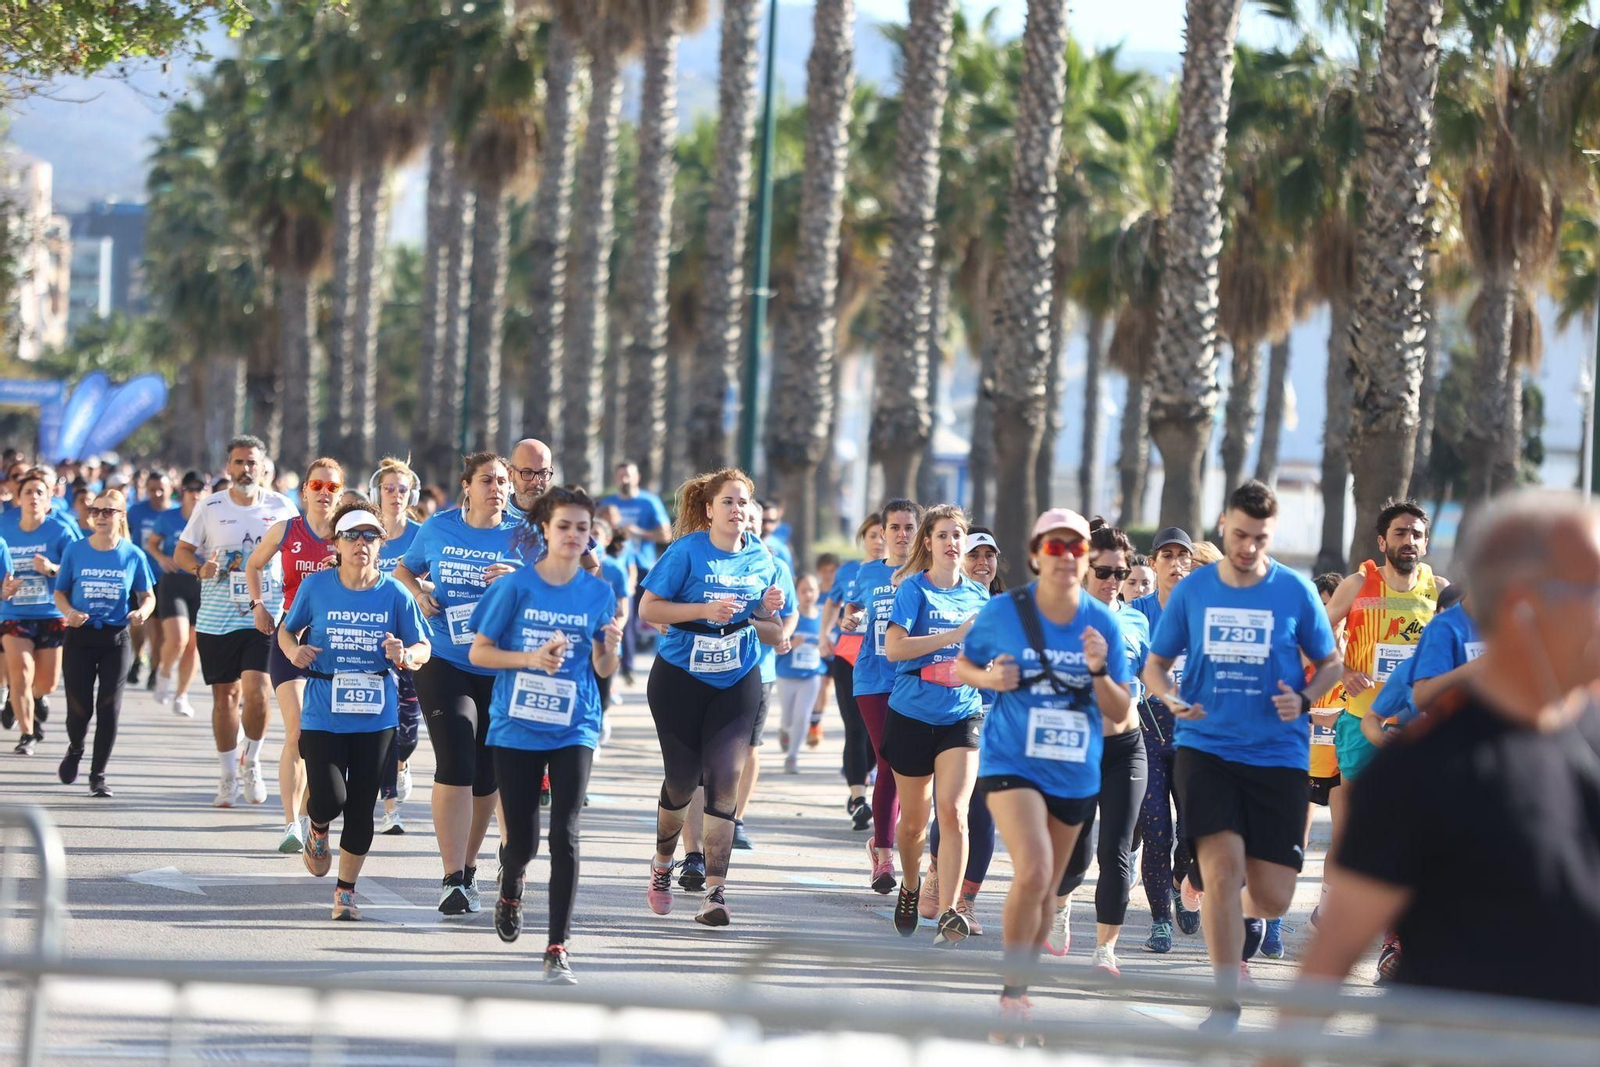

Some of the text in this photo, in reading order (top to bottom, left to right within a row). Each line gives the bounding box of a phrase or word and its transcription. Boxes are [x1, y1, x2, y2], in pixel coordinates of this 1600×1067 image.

[291, 541, 302, 554] 3
[442, 546, 501, 562] mayoral
[81, 568, 126, 578] mayoral
[441, 576, 487, 588] FRIENDS
[327, 611, 389, 624] mayoral
[524, 608, 588, 627] mayoral
[326, 628, 385, 638] RUNNING
[1219, 627, 1256, 642] 730
[330, 635, 378, 645] MAKES
[330, 643, 378, 652] FRIENDS
[703, 650, 731, 662] 565
[344, 690, 375, 702] 497
[525, 692, 561, 711] 252
[1043, 729, 1080, 747] 349
